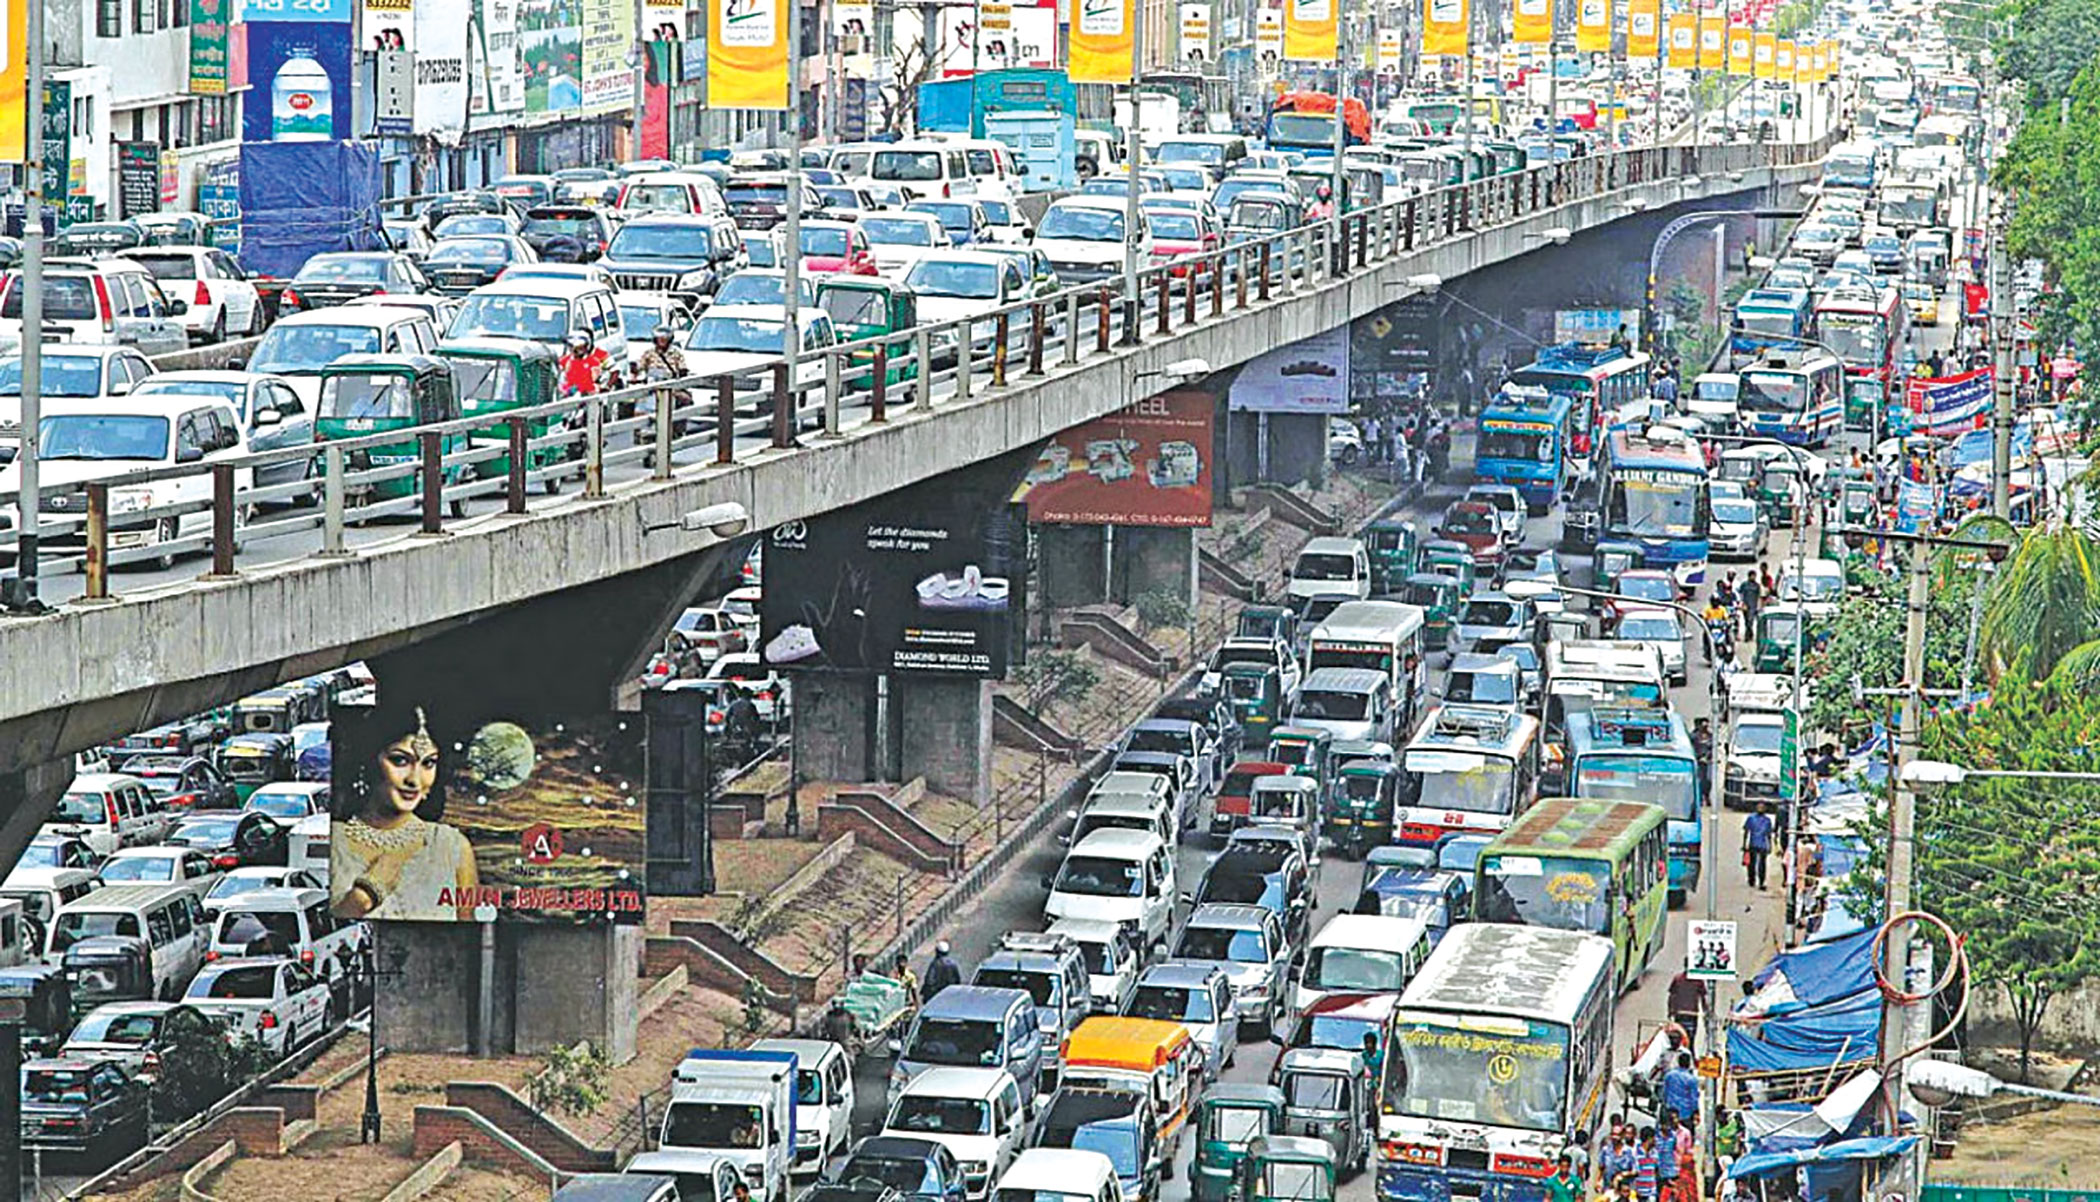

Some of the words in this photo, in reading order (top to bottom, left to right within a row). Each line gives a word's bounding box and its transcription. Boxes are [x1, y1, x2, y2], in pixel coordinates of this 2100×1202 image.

[894, 651, 937, 662] DIAMOND
[938, 653, 970, 663] WORLD
[528, 834, 554, 860] A
[437, 887, 502, 908] AMIN
[506, 888, 605, 911] JEWELLERS
